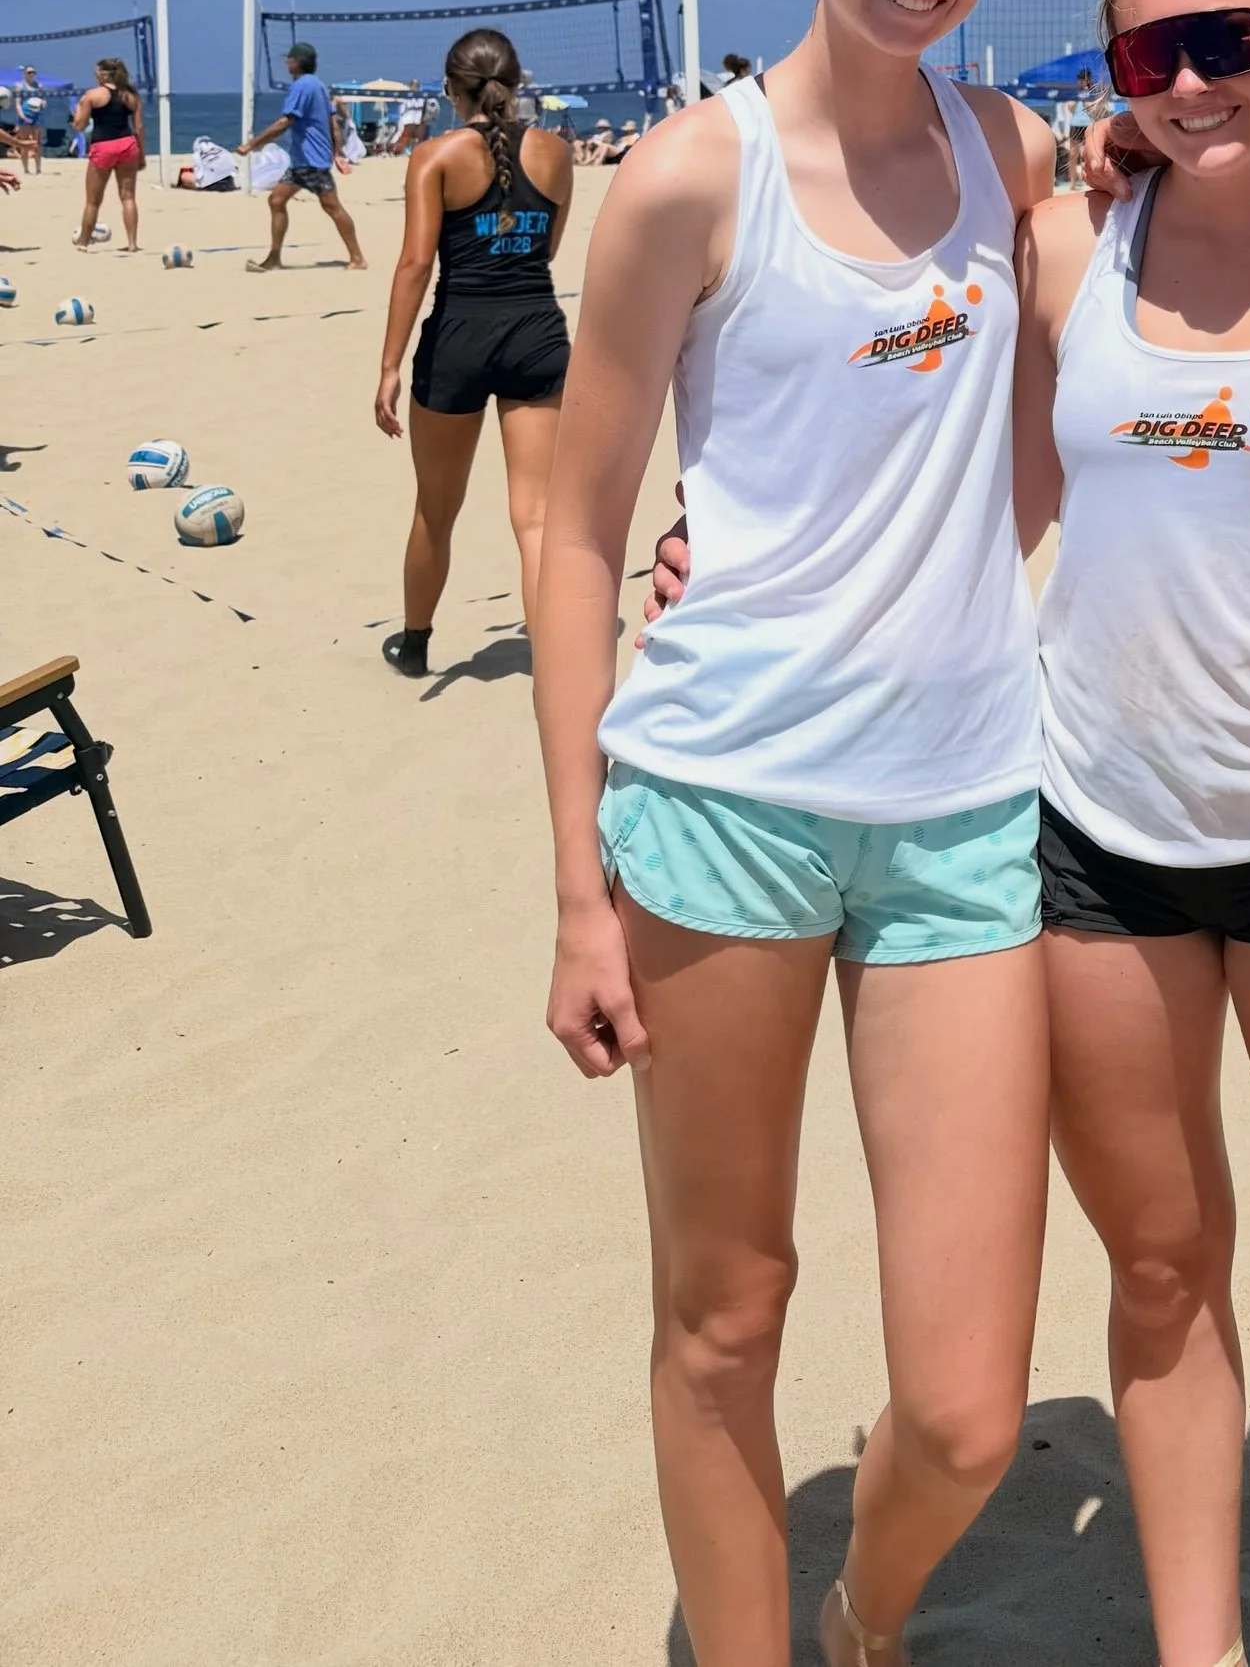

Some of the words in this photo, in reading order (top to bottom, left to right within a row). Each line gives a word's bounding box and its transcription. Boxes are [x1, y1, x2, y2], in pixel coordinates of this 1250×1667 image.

[475, 211, 550, 237] WIDER
[871, 330, 911, 357] DIG
[915, 313, 969, 345] DEEP
[890, 324, 905, 332] Luis
[887, 348, 911, 361] Beach
[911, 336, 947, 353] Volleyball
[946, 331, 964, 342] Club
[1174, 412, 1204, 420] Obispo
[1132, 420, 1178, 437] DIG
[1180, 420, 1249, 439] DEEP
[1175, 438, 1217, 447] Volleyball
[1218, 440, 1238, 448] Club
